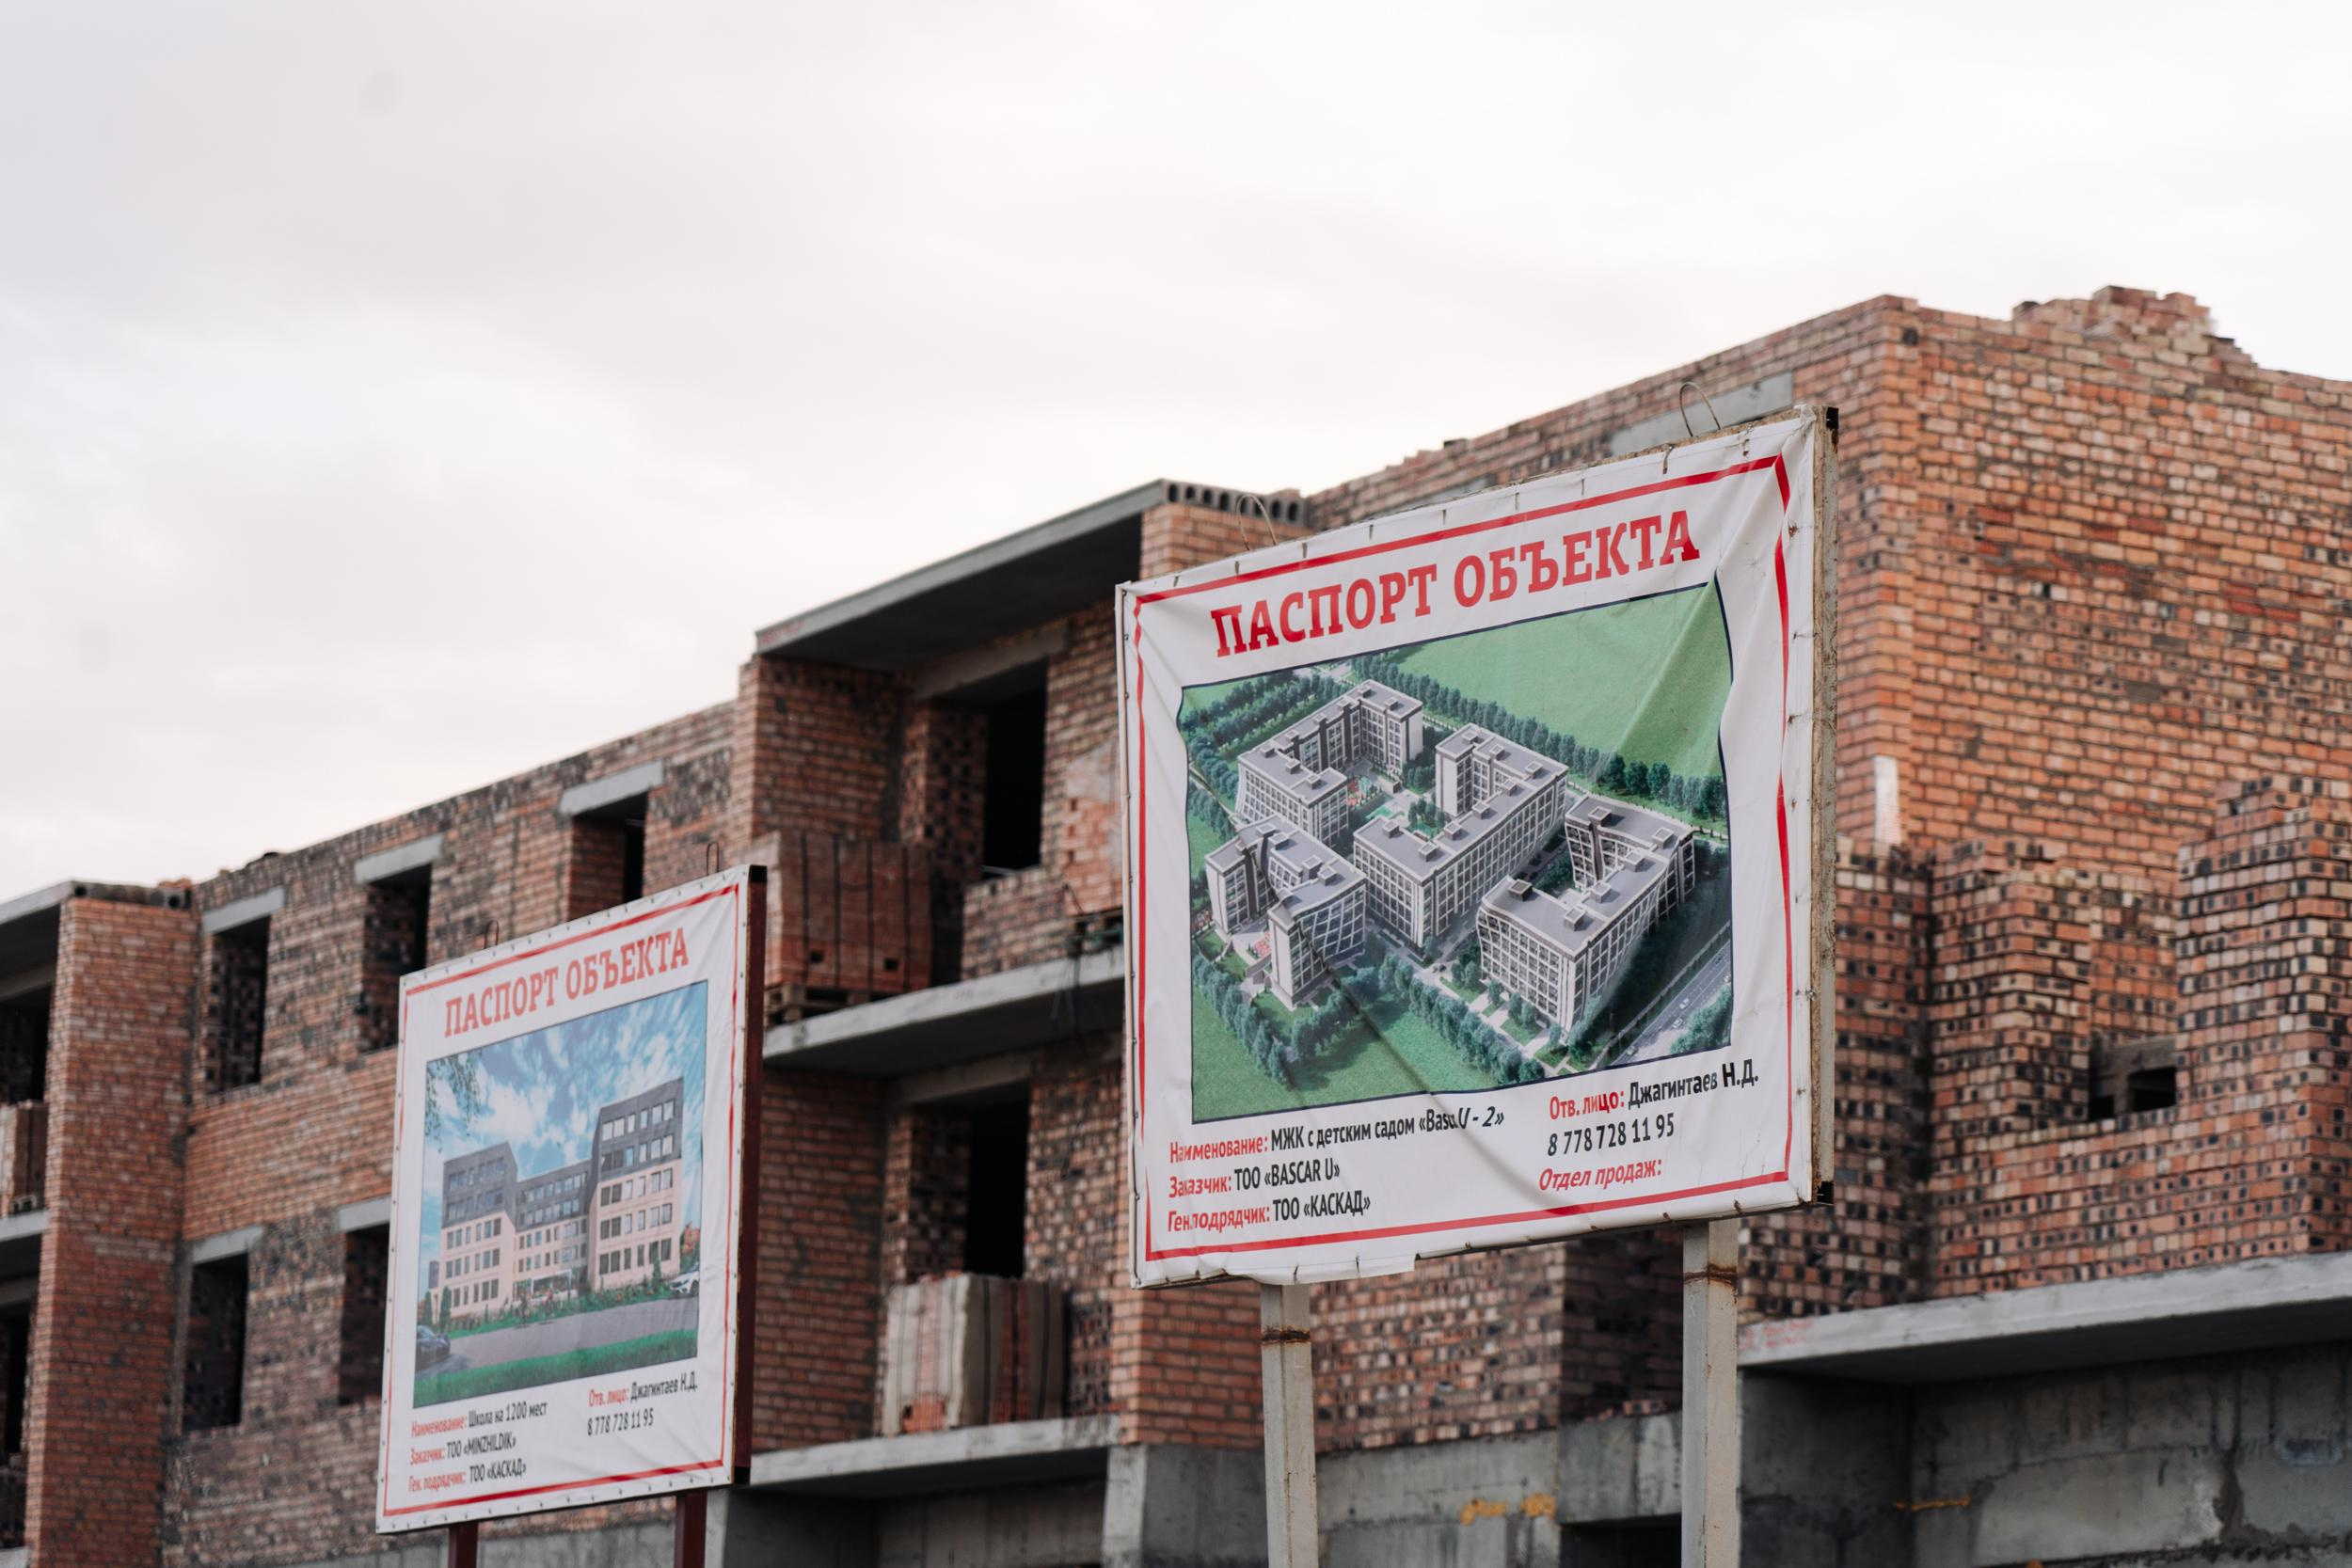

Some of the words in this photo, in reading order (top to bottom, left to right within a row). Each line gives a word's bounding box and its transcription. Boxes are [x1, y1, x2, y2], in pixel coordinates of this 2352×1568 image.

[1210, 563, 1437, 657] ПАСПОРТ
[1454, 510, 1700, 608] ОБЪЕКТА
[444, 966, 559, 1038] ПАСПОРТ
[566, 927, 689, 1000] ОБЪЕКТА
[1549, 1096, 1580, 1119] Отв.
[1582, 1090, 1625, 1114] лицо:
[1628, 1072, 1718, 1110] Джагинтаев
[1722, 1059, 1758, 1088] Н.Д.
[1170, 1136, 1268, 1164] Наименование:
[1271, 1126, 1304, 1151] МЖК
[1308, 1129, 1313, 1147] с
[1316, 1123, 1371, 1148] детским
[1375, 1117, 1414, 1140] садом
[1548, 1133, 1558, 1157] 8
[1564, 1128, 1593, 1154] 778
[1597, 1121, 1626, 1149] 728
[1631, 1117, 1651, 1143] 11
[1656, 1113, 1675, 1138] 95
[1168, 1176, 1232, 1198] Заказчик:
[1234, 1166, 1261, 1191] ТОО
[1264, 1160, 1321, 1187] «BASCAR
[1325, 1158, 1340, 1180] U»
[1539, 1168, 1591, 1191] Отдел
[1595, 1159, 1661, 1189] продаж:
[1273, 1197, 1299, 1222] ТОО
[1304, 1190, 1371, 1218] «КАСКАД»
[630, 1379, 678, 1402] Джагинтаев
[680, 1370, 697, 1392] Н.Д.
[411, 1416, 467, 1437] Наименование:
[469, 1410, 493, 1428] Школа
[494, 1410, 503, 1422] на
[506, 1401, 527, 1421] 1200
[529, 1402, 548, 1418] мест
[587, 1418, 593, 1436] 8
[595, 1415, 611, 1435] 778
[612, 1412, 628, 1432] 728
[631, 1409, 641, 1429] 11
[644, 1407, 654, 1427] 95
[447, 1440, 461, 1459] ТОО
[469, 1464, 485, 1483] ТОО
[487, 1458, 526, 1480] «КАСКАД»
